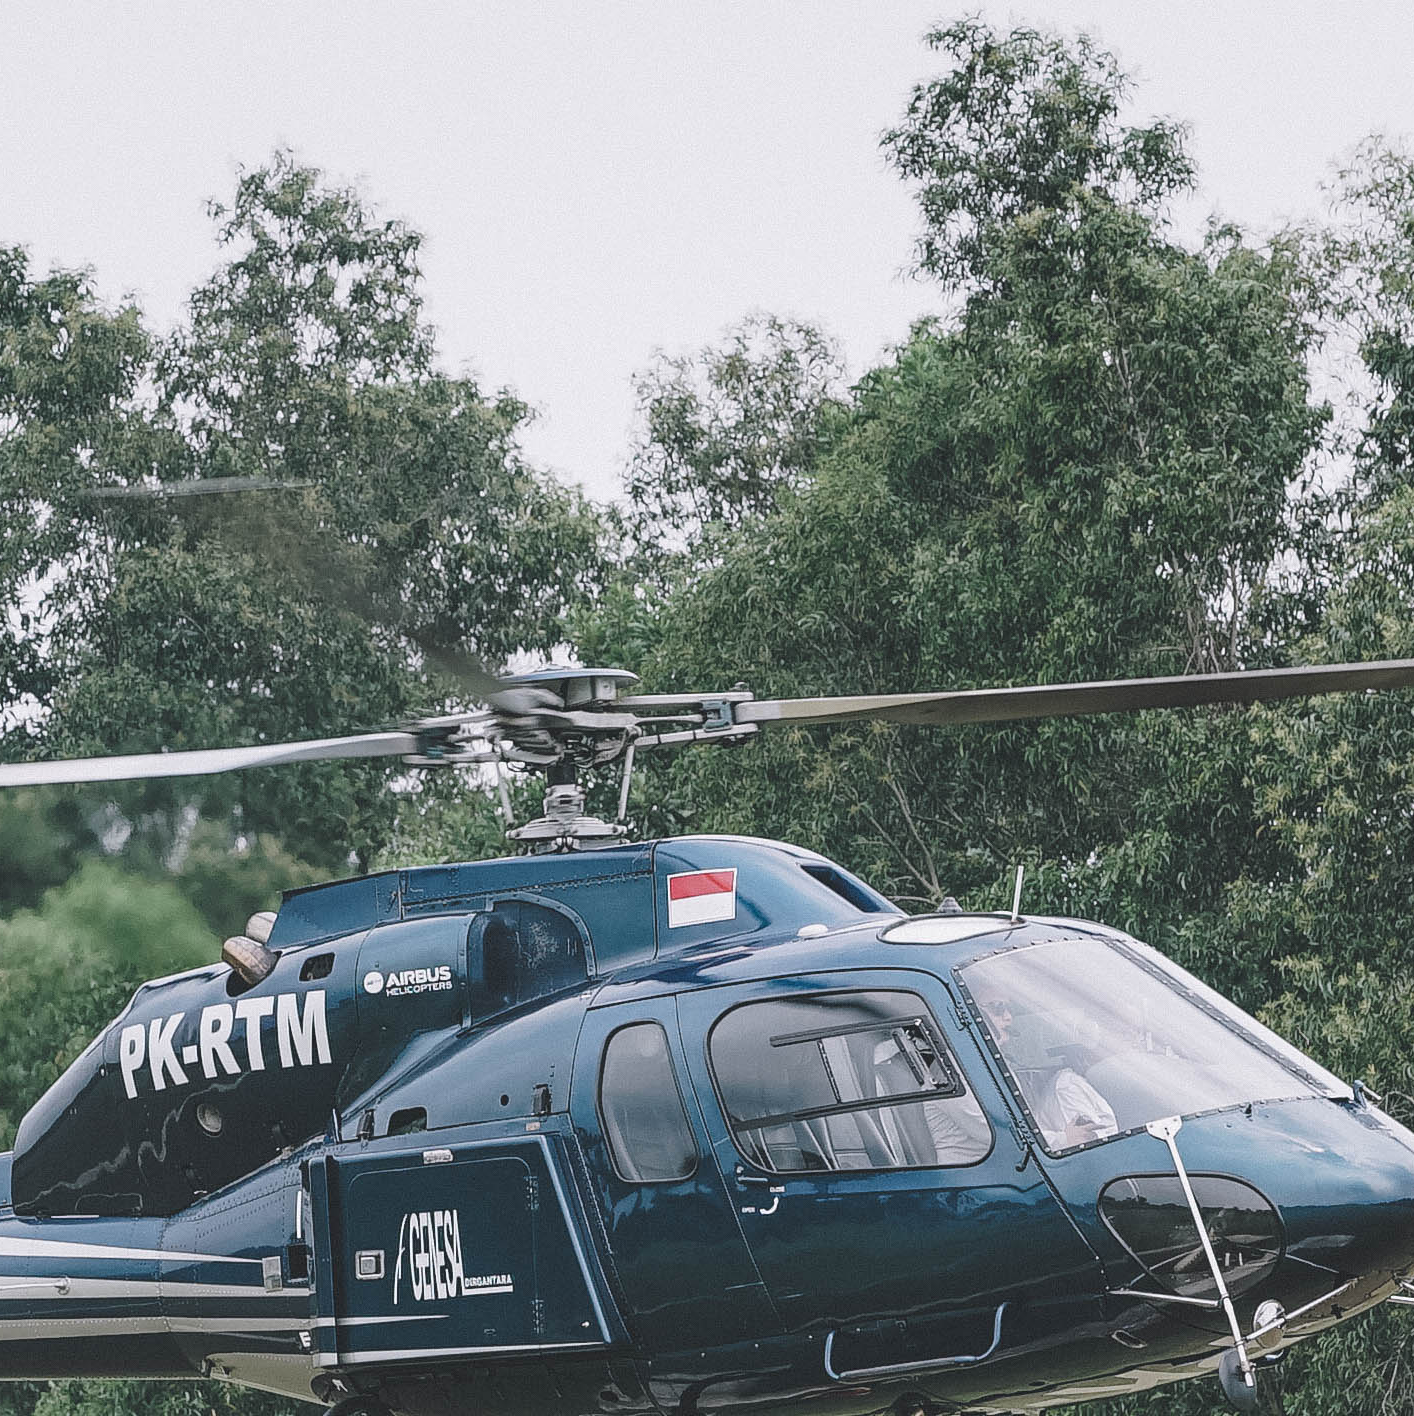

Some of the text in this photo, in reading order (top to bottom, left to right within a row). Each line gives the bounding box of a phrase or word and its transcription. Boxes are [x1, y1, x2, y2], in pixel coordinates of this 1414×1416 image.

[386, 966, 452, 988] AIRBUS
[386, 981, 453, 998] HELICOPTERS
[120, 989, 332, 1100] PK-RTM
[409, 1209, 464, 1301] GENESA
[464, 1274, 513, 1288] DIRGANTARA
